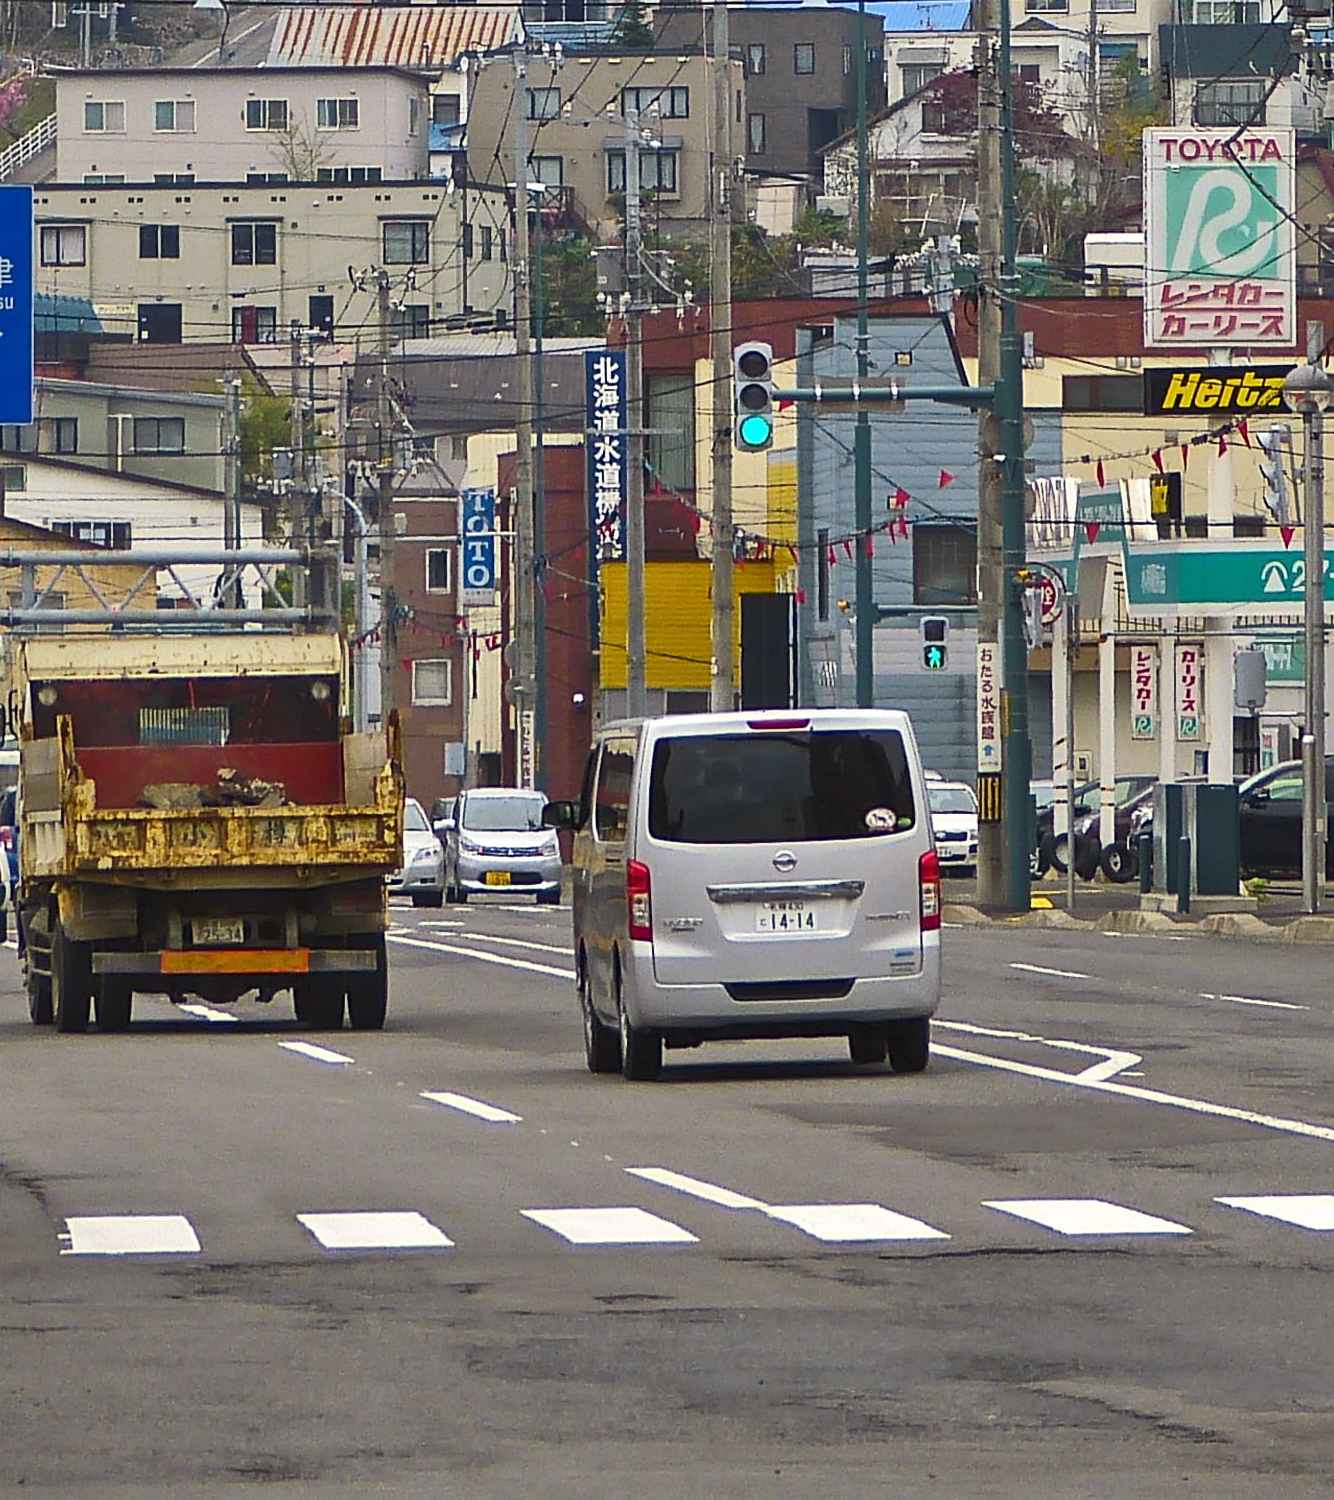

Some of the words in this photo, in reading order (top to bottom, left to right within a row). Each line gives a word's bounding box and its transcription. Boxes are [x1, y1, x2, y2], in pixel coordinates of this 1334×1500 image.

[1159, 138, 1283, 161] TOYOTA
[1161, 284, 1284, 306] レンタカー
[1161, 314, 1284, 337] カーリース
[1163, 372, 1287, 410] Hertz
[467, 490, 490, 587] TOTO
[980, 648, 997, 740] おたる水族館
[1136, 651, 1152, 711] レンタカー
[1181, 650, 1196, 711] カーリース
[771, 912, 815, 930] 14-14
